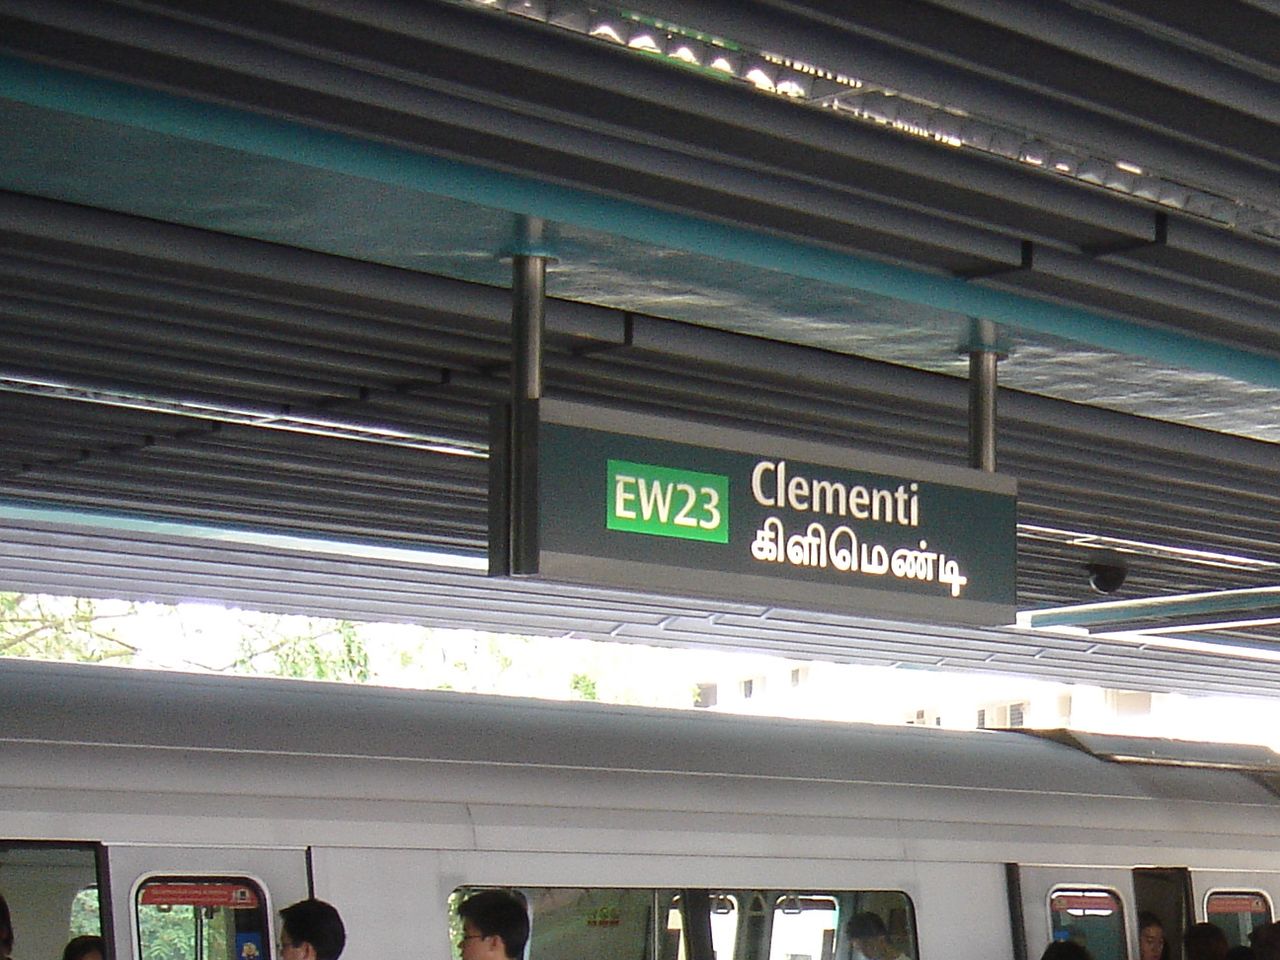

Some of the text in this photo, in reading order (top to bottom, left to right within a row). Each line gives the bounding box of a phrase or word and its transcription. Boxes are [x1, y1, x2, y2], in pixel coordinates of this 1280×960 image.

[615, 474, 721, 530] EW23
[751, 460, 919, 526] Clementi
[751, 516, 968, 597] கிளிமெண்டி
